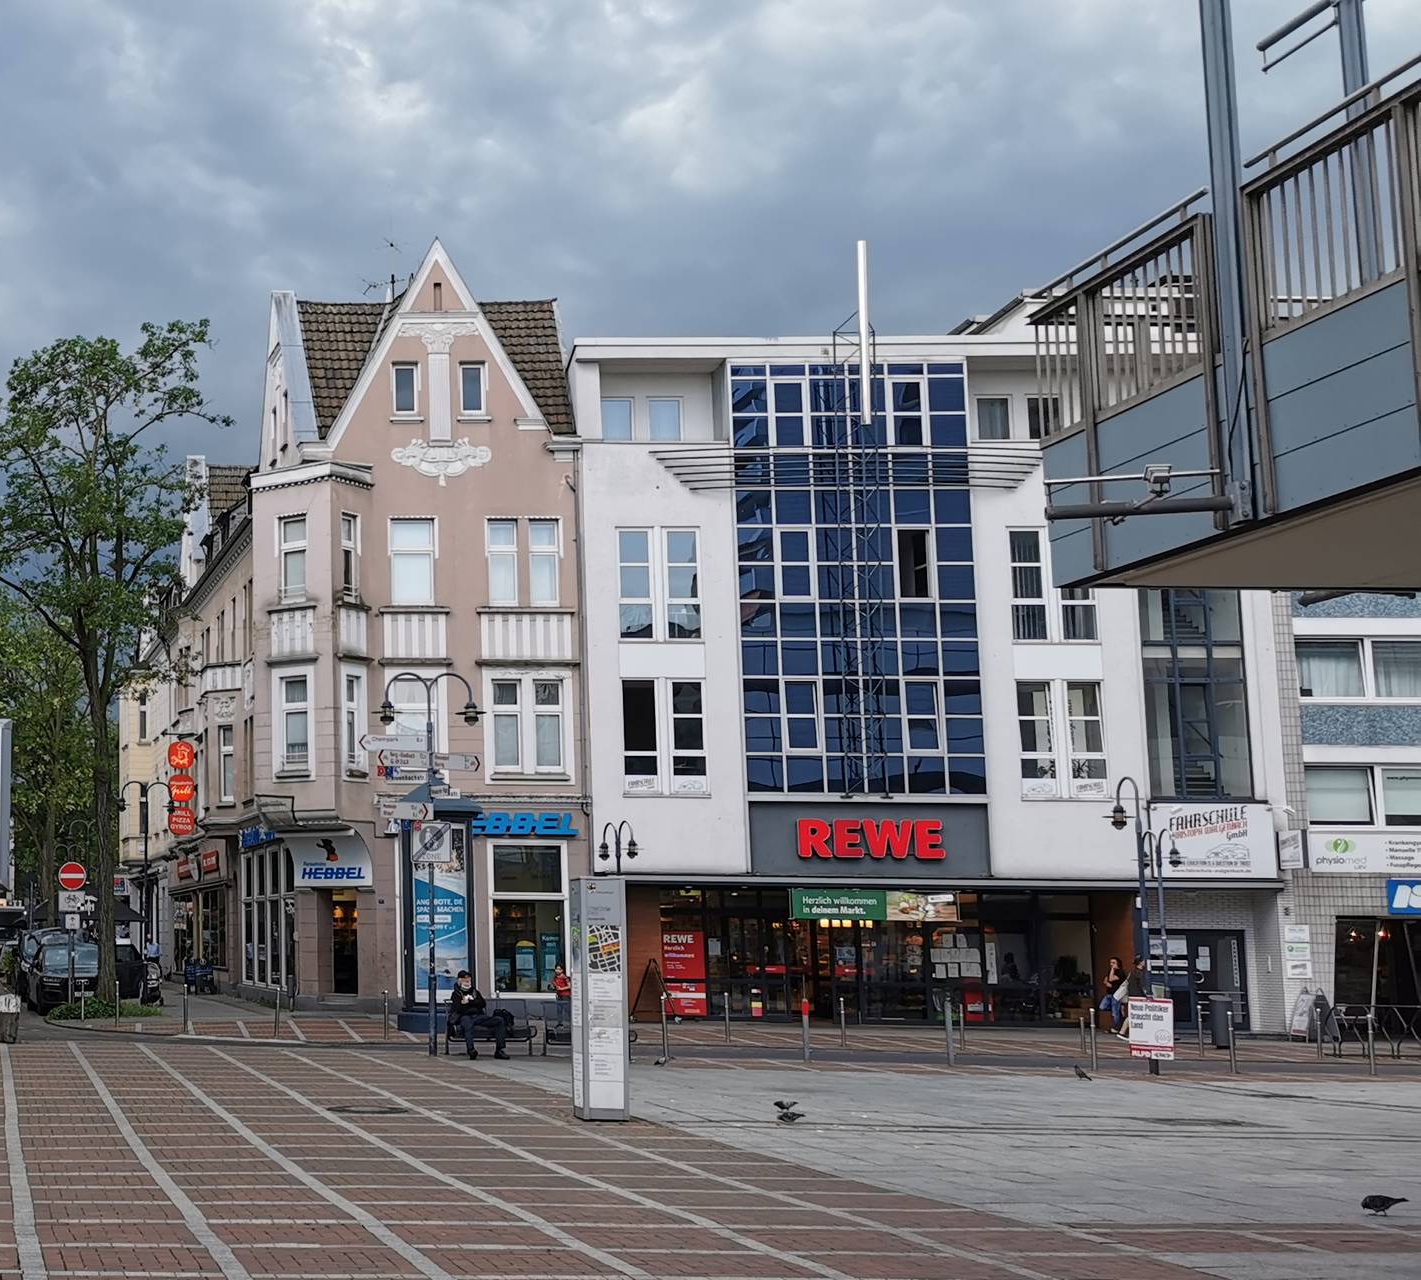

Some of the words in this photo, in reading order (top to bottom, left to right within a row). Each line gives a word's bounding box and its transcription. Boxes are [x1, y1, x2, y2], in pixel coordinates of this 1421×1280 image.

[1169, 805, 1247, 832] FAHRSCHULE
[472, 812, 578, 836] EBBEL
[797, 818, 946, 860] REWE
[1316, 856, 1367, 866] physiomed
[301, 867, 366, 880] HEBBEL
[802, 896, 832, 905] Herzlich
[834, 896, 877, 905] willkommen
[812, 906, 839, 914] deinem
[841, 906, 867, 914] Markt.
[663, 934, 695, 944] REWE
[1145, 1004, 1169, 1013] Politiker
[1131, 1012, 1152, 1020] braucht
[1131, 1021, 1144, 1029] Land
